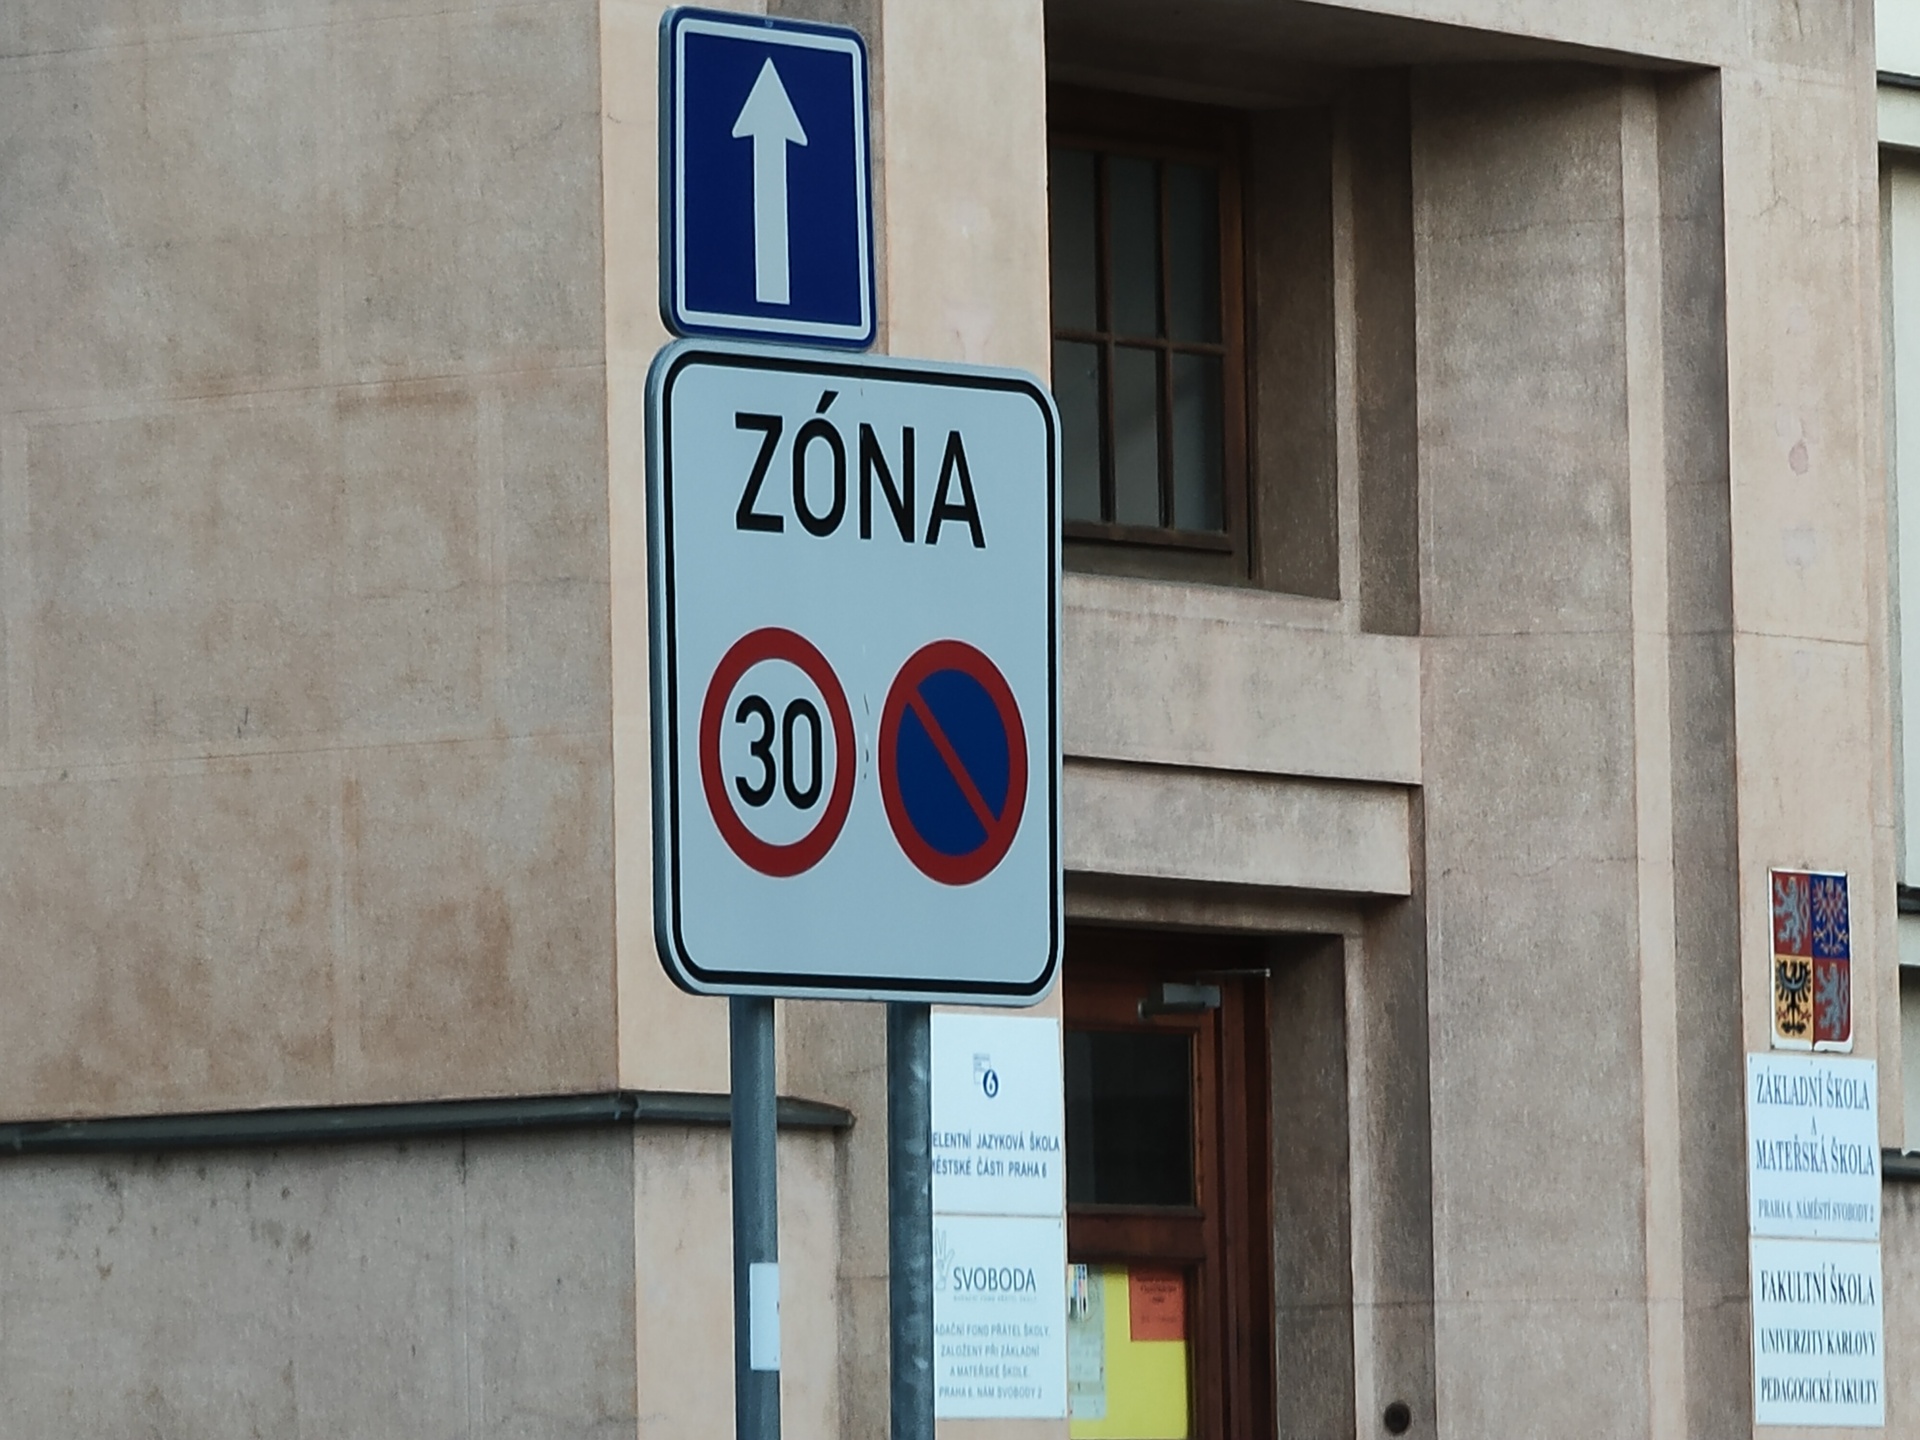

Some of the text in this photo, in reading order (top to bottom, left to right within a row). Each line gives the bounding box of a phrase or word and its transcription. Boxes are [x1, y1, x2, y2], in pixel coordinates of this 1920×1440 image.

[734, 390, 986, 549] ZÓNA
[735, 695, 823, 810] 30
[1756, 1065, 1870, 1110] ZÁKLADNÍ ŠKOLA
[1811, 1115, 1817, 1136] A
[976, 1131, 1024, 1151] JAZYKOVÁ
[1030, 1131, 1060, 1152] ŠKOLA
[1756, 1134, 1875, 1176] MATEŘSKÁ ŠKOLA
[976, 1156, 1004, 1176] ČÁSTI
[1008, 1160, 1040, 1177] PRAHA
[1042, 1161, 1047, 1178] 6
[1758, 1198, 1785, 1219] PRAHA
[953, 1266, 1036, 1292] SVOBODA
[1761, 1262, 1875, 1306] FAKULTNÍ ŠKOLA
[966, 1323, 990, 1337] FOND
[1761, 1328, 1876, 1356] UNIVERZITY KARLOVY
[1761, 1370, 1878, 1405] PEDAGOGICKÉ FAKULTY
